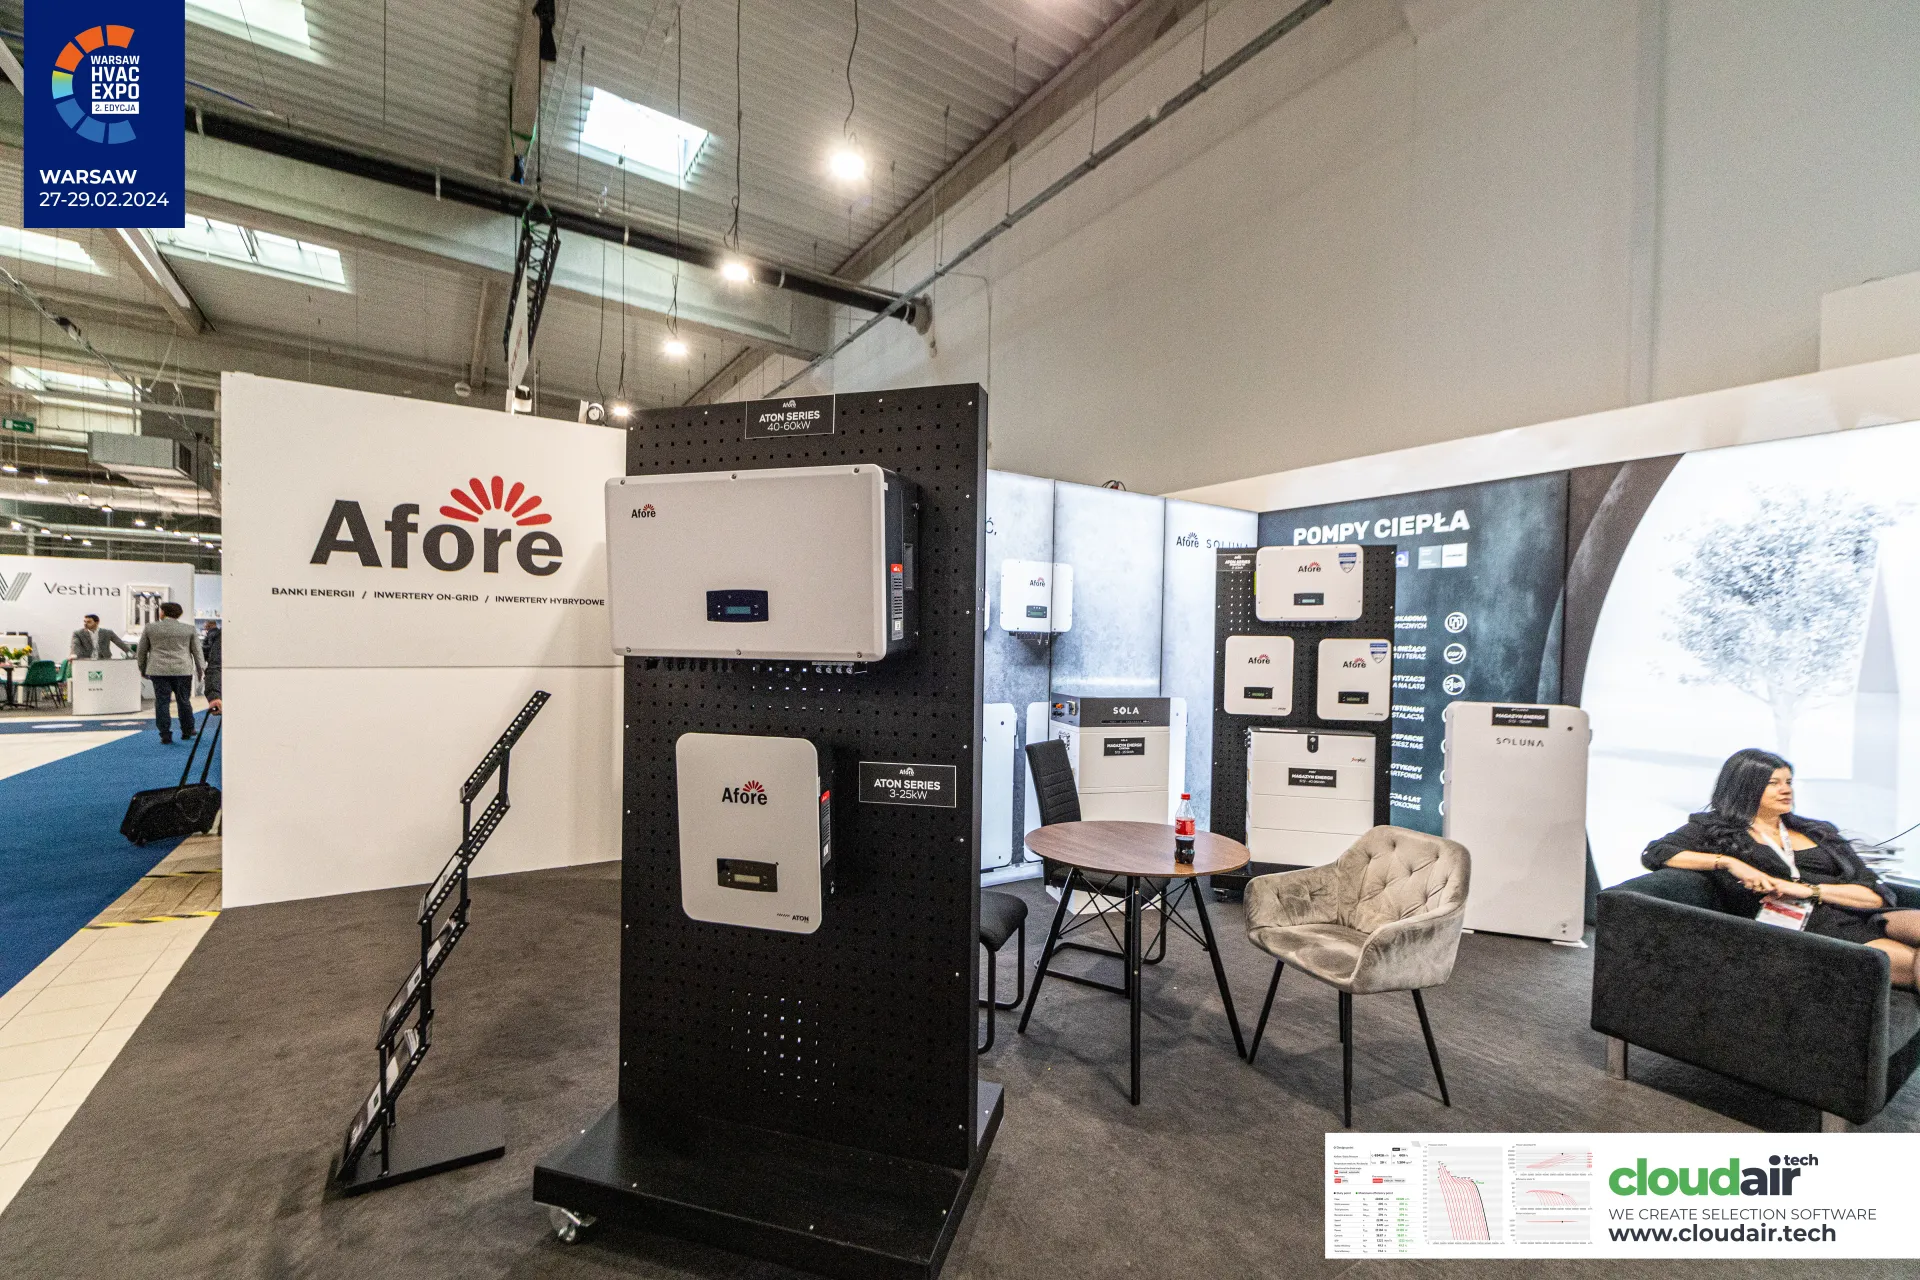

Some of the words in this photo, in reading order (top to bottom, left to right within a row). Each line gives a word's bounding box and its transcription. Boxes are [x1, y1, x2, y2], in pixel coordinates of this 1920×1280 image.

[759, 413, 785, 423] ATON
[786, 410, 820, 420] SERIES
[767, 420, 811, 432] 40-60kW
[631, 508, 656, 518] Afore
[1293, 520, 1371, 546] POMPY
[1373, 509, 1471, 539] CIEPŁA
[310, 499, 563, 577] Afore
[1176, 536, 1200, 548] Afore
[1298, 565, 1322, 573] Afore
[44, 582, 121, 597] Vestima
[1030, 580, 1046, 588] Afore
[271, 587, 308, 596] BANKI
[310, 588, 354, 598] ENERGII
[374, 590, 434, 600] INWERTERY
[436, 592, 479, 602] ON-GRID
[495, 595, 548, 604] INWERTERY
[550, 597, 606, 606] HYBRYDOWE
[1248, 657, 1271, 665] Afore
[1342, 660, 1367, 669] Afore
[1112, 706, 1140, 715] SOLA
[1496, 737, 1544, 748] SOLUNA
[874, 778, 902, 788] ATON
[904, 780, 941, 790] SERIES
[722, 788, 768, 806] Afore
[889, 788, 928, 800] 3-25kW
[792, 914, 810, 922] ATON
